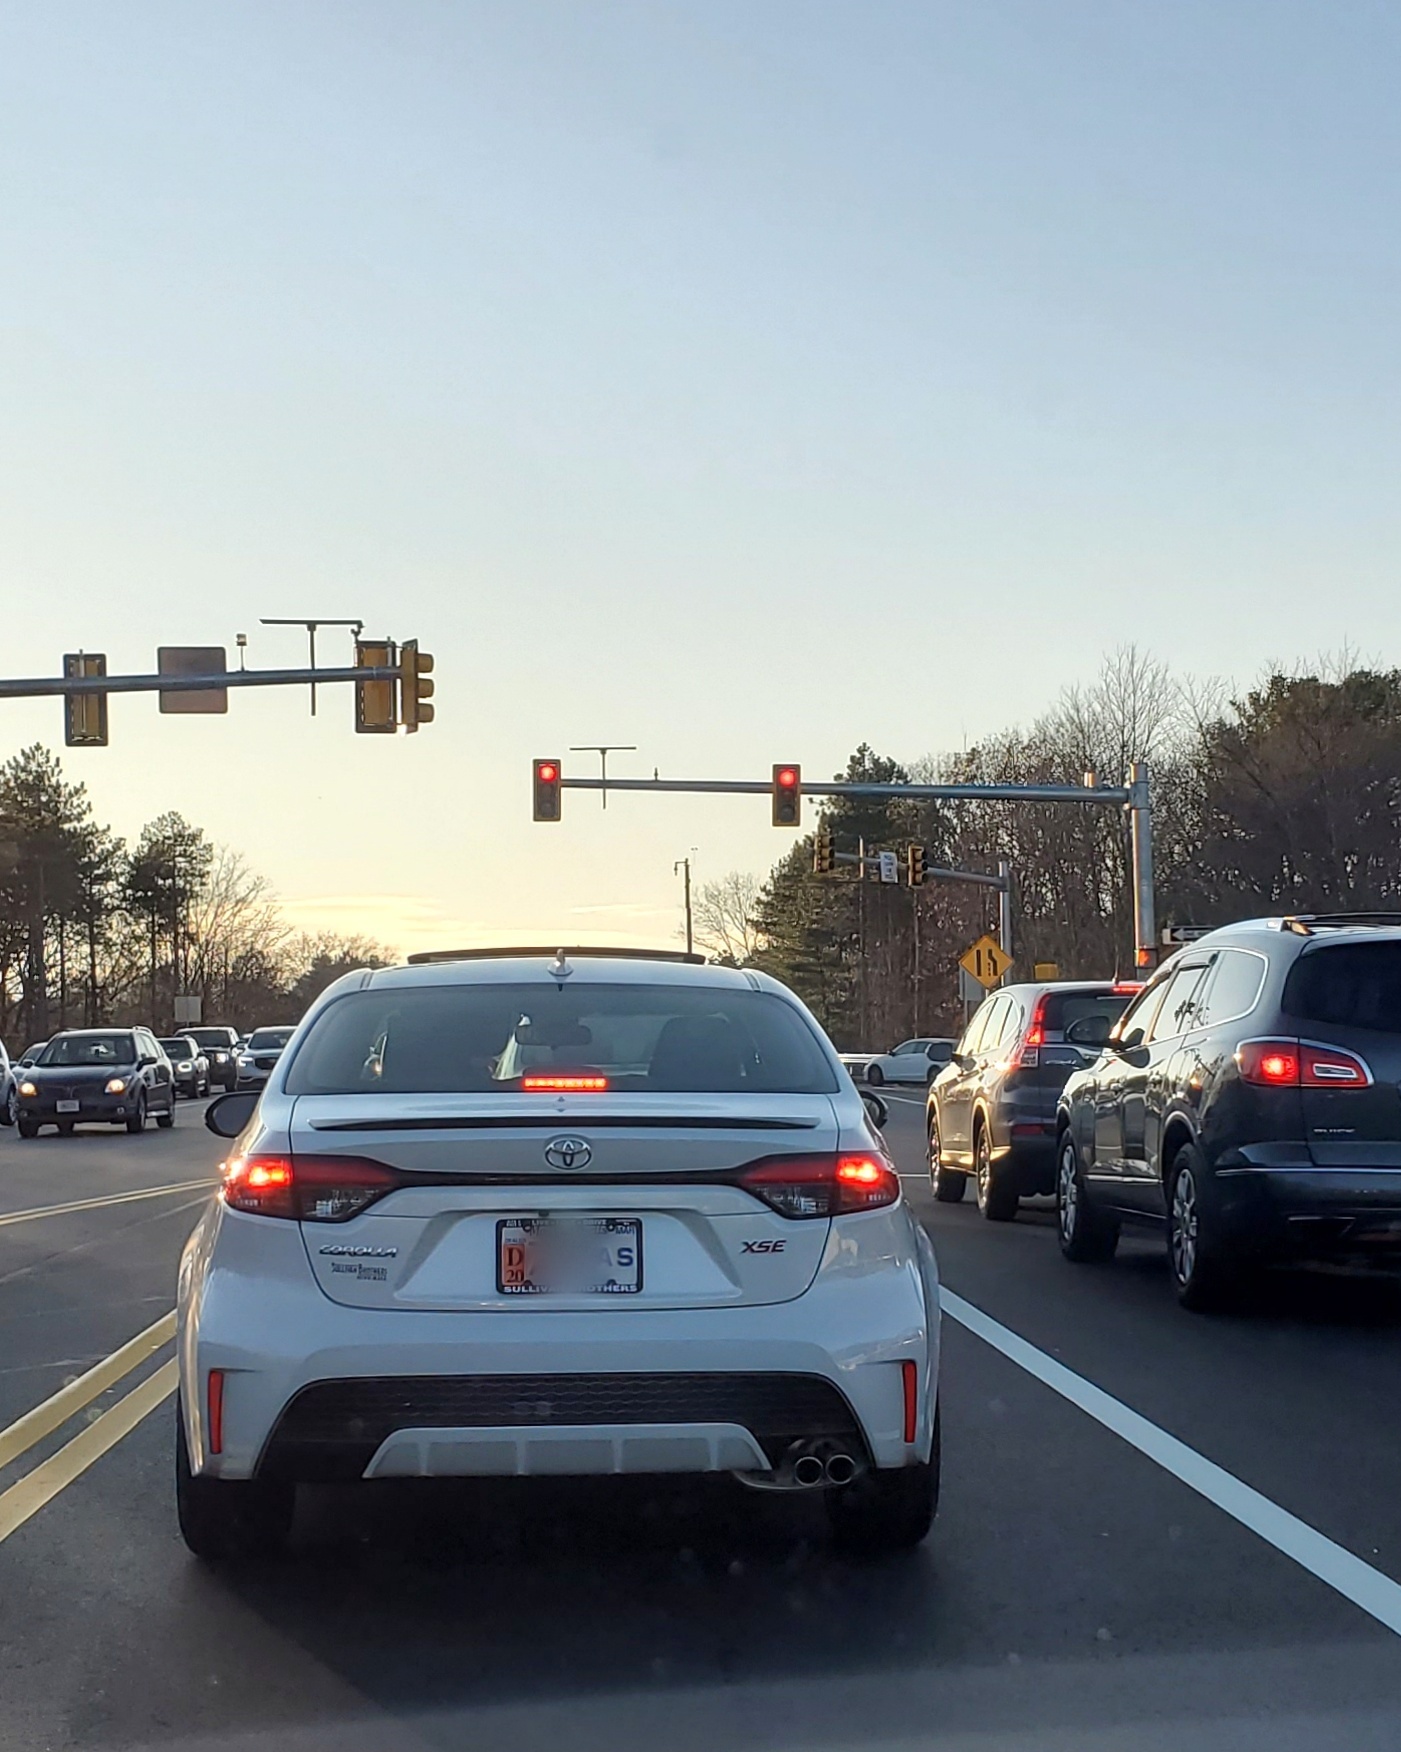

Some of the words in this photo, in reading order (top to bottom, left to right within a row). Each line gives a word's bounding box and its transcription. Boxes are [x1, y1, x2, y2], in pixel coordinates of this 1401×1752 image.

[318, 1244, 398, 1258] COROLLA
[740, 1239, 788, 1254] XSE
[506, 1246, 524, 1267] D
[506, 1269, 525, 1284] 20
